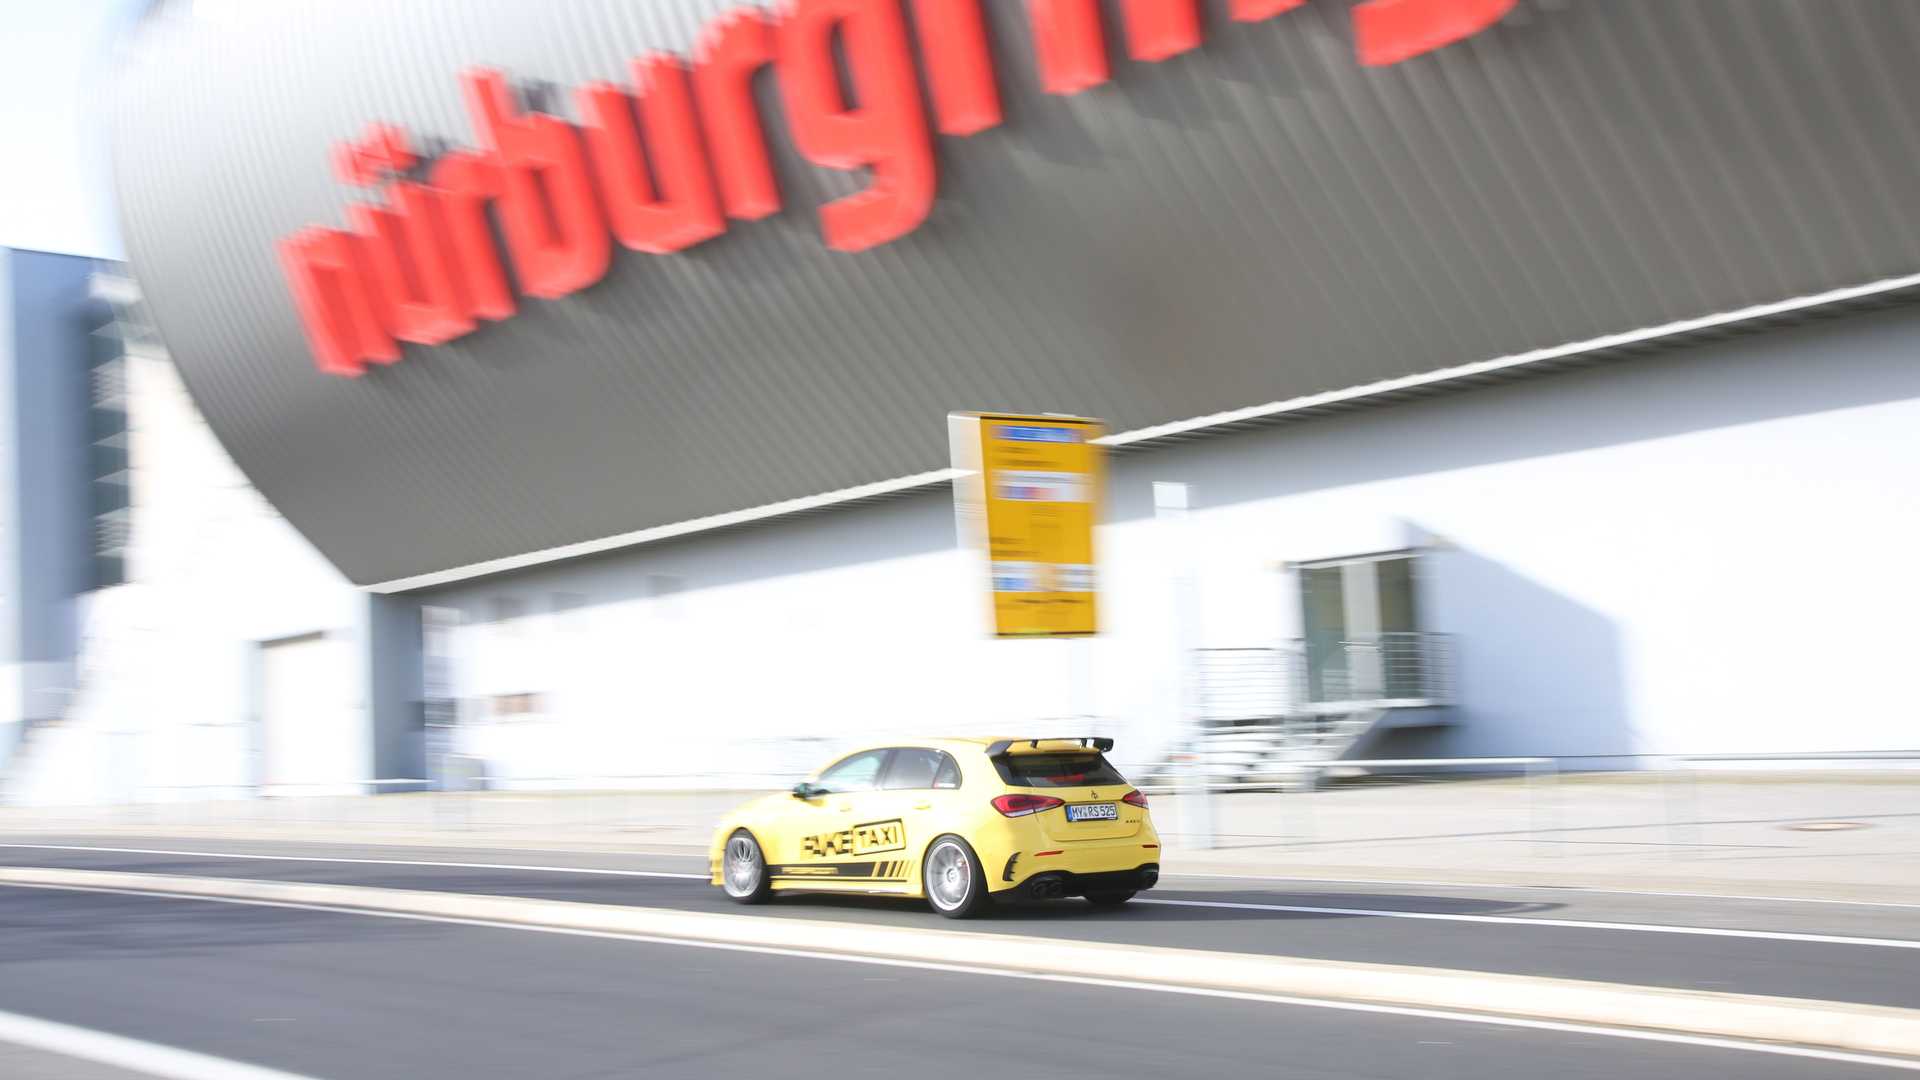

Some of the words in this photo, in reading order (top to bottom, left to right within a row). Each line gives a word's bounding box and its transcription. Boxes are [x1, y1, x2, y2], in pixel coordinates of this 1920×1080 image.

[1087, 806, 1099, 817] RS
[1100, 805, 1115, 817] 525
[803, 830, 853, 857] FAKE
[857, 825, 898, 848] TAXI
